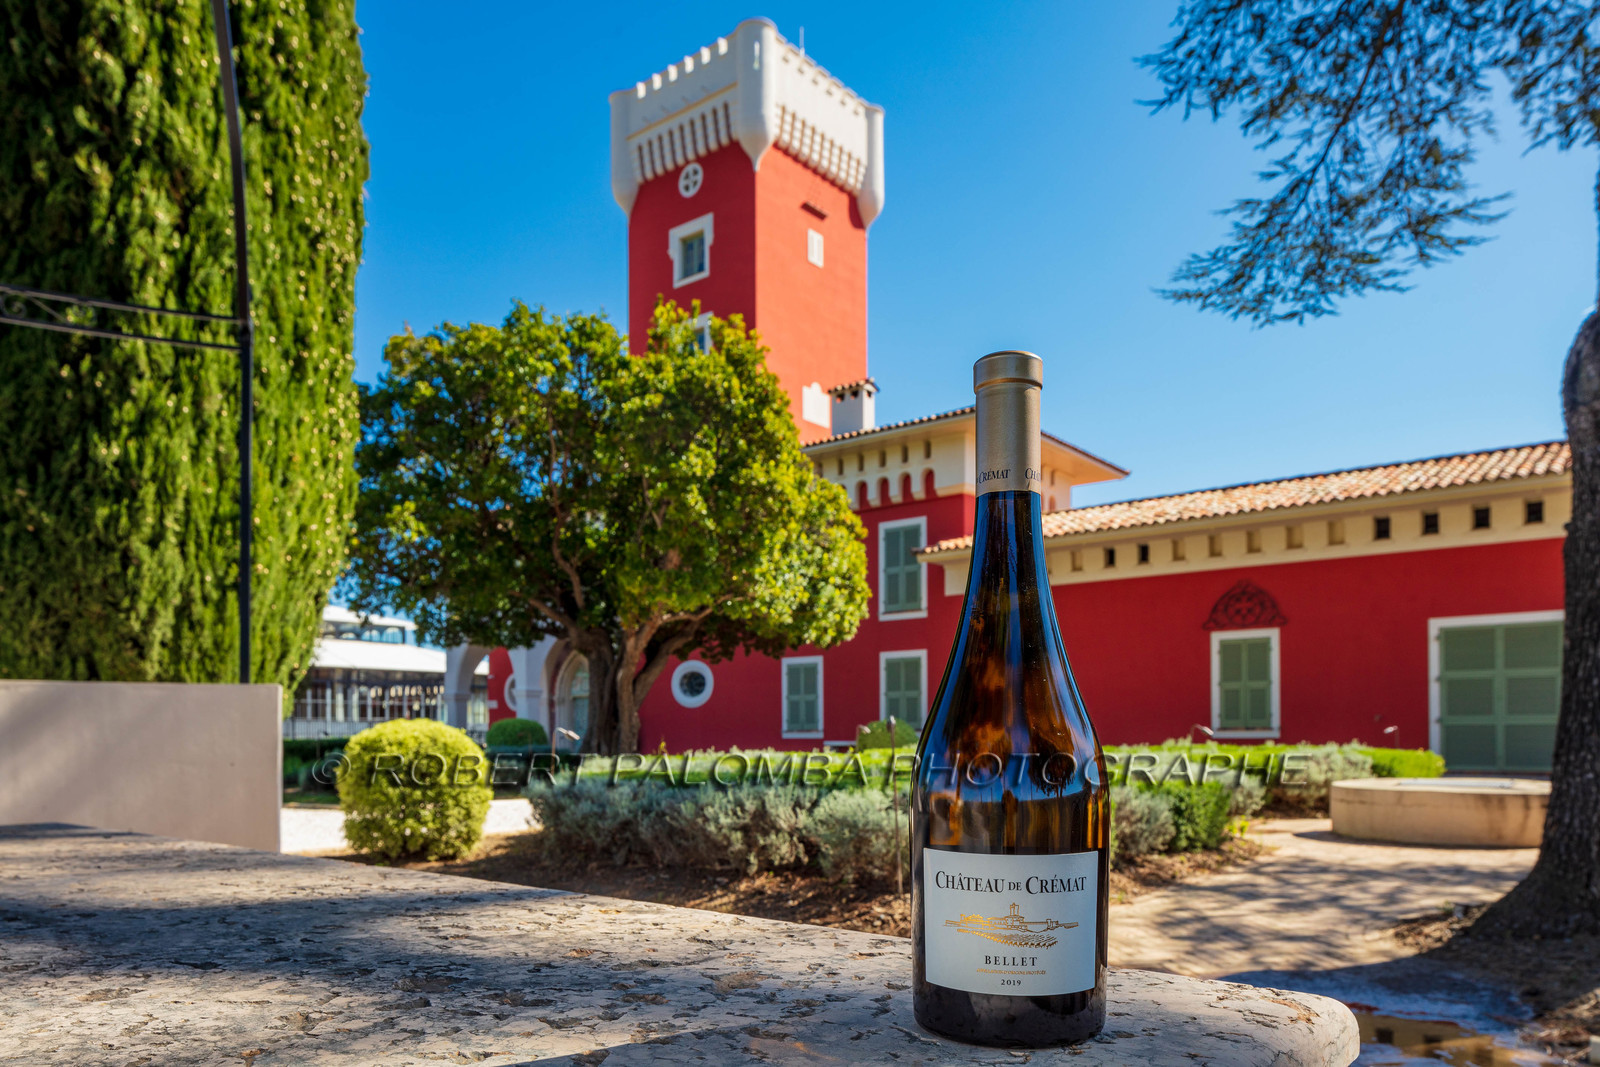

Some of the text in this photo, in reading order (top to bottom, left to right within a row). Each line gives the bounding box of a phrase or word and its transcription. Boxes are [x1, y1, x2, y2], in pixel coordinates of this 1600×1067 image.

[978, 468, 1011, 484] CRÉMAT
[935, 870, 1087, 895] CHÂTEAU DE CRÉMAT
[984, 955, 1038, 967] BELLET
[1000, 978, 1022, 987] 2019
